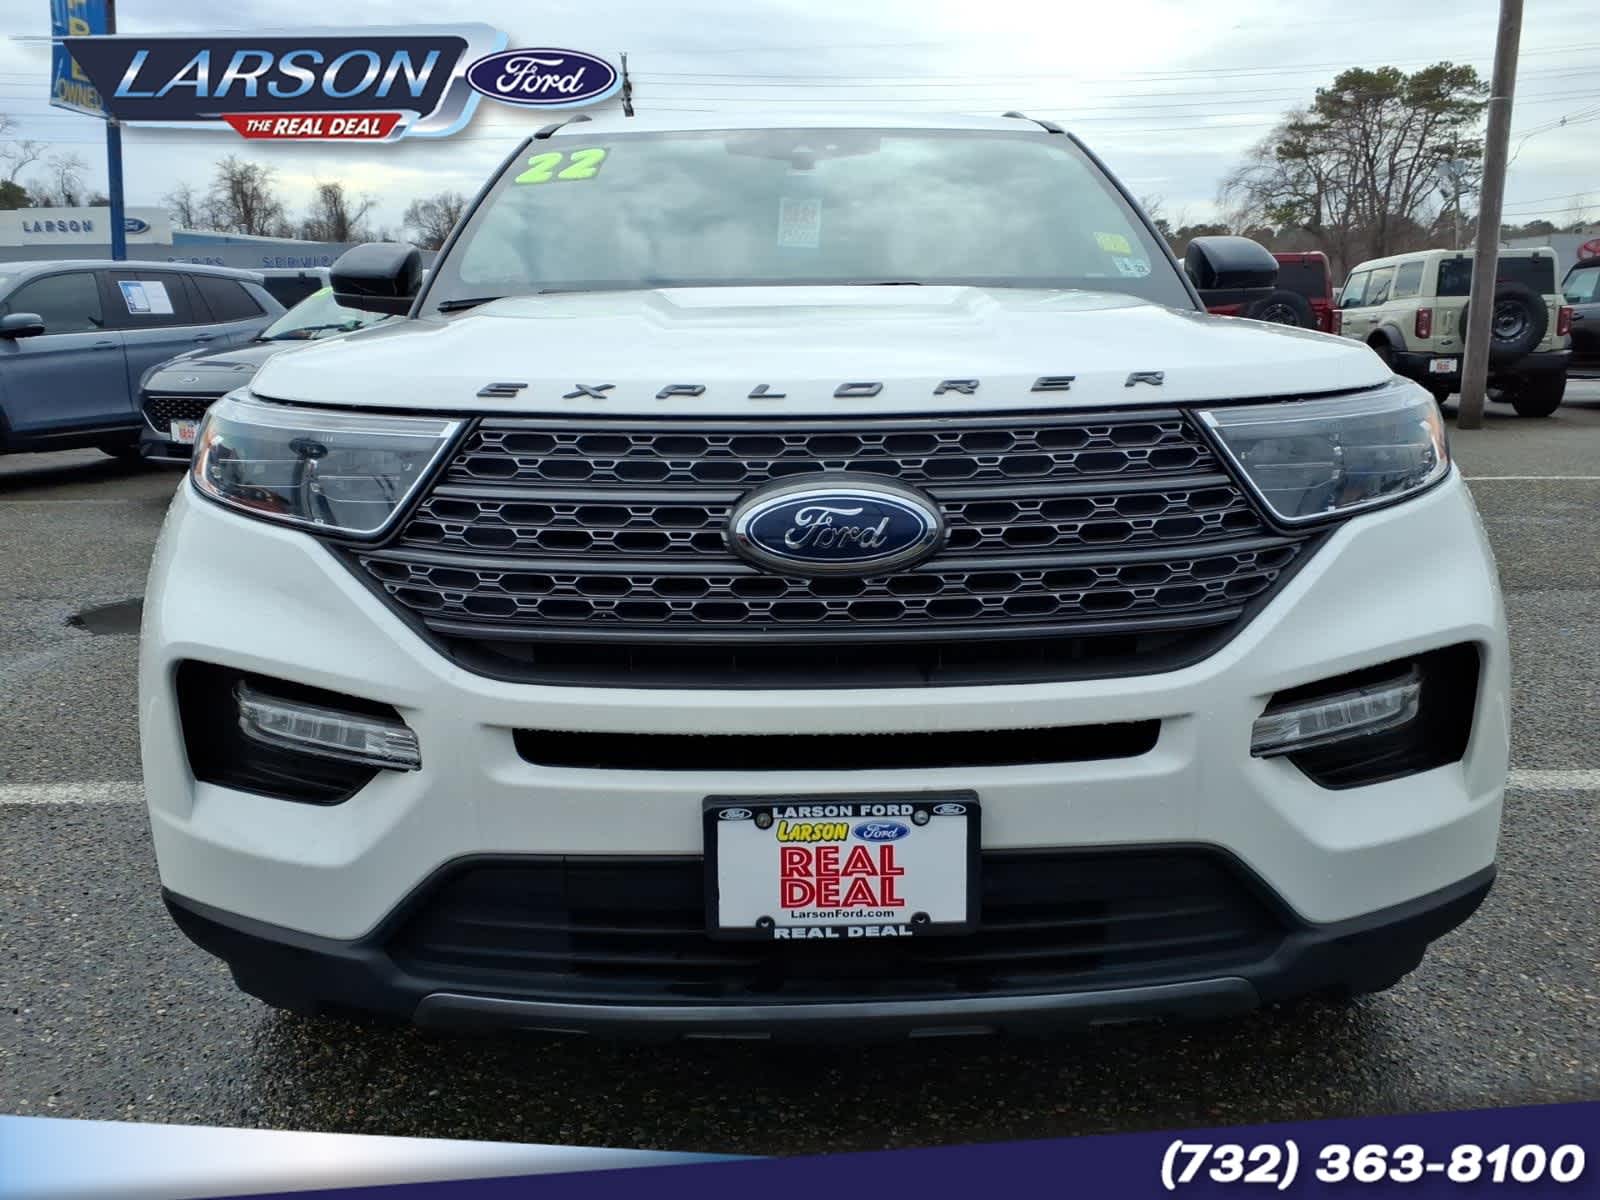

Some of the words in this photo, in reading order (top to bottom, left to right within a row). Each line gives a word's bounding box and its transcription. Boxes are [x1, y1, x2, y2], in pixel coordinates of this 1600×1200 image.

[515, 148, 605, 184] 22
[22, 220, 93, 233] LARSON
[476, 370, 1165, 399] EXPLORER
[784, 506, 890, 550] Ford
[772, 805, 852, 819] LARSON
[860, 804, 913, 816] FORD
[863, 823, 899, 840] Ford
[780, 845, 905, 877] REAL
[780, 877, 905, 908] DEAL
[790, 909, 895, 919] LarsonFord.com
[773, 926, 839, 940] REAL
[847, 925, 913, 938] DEAL
